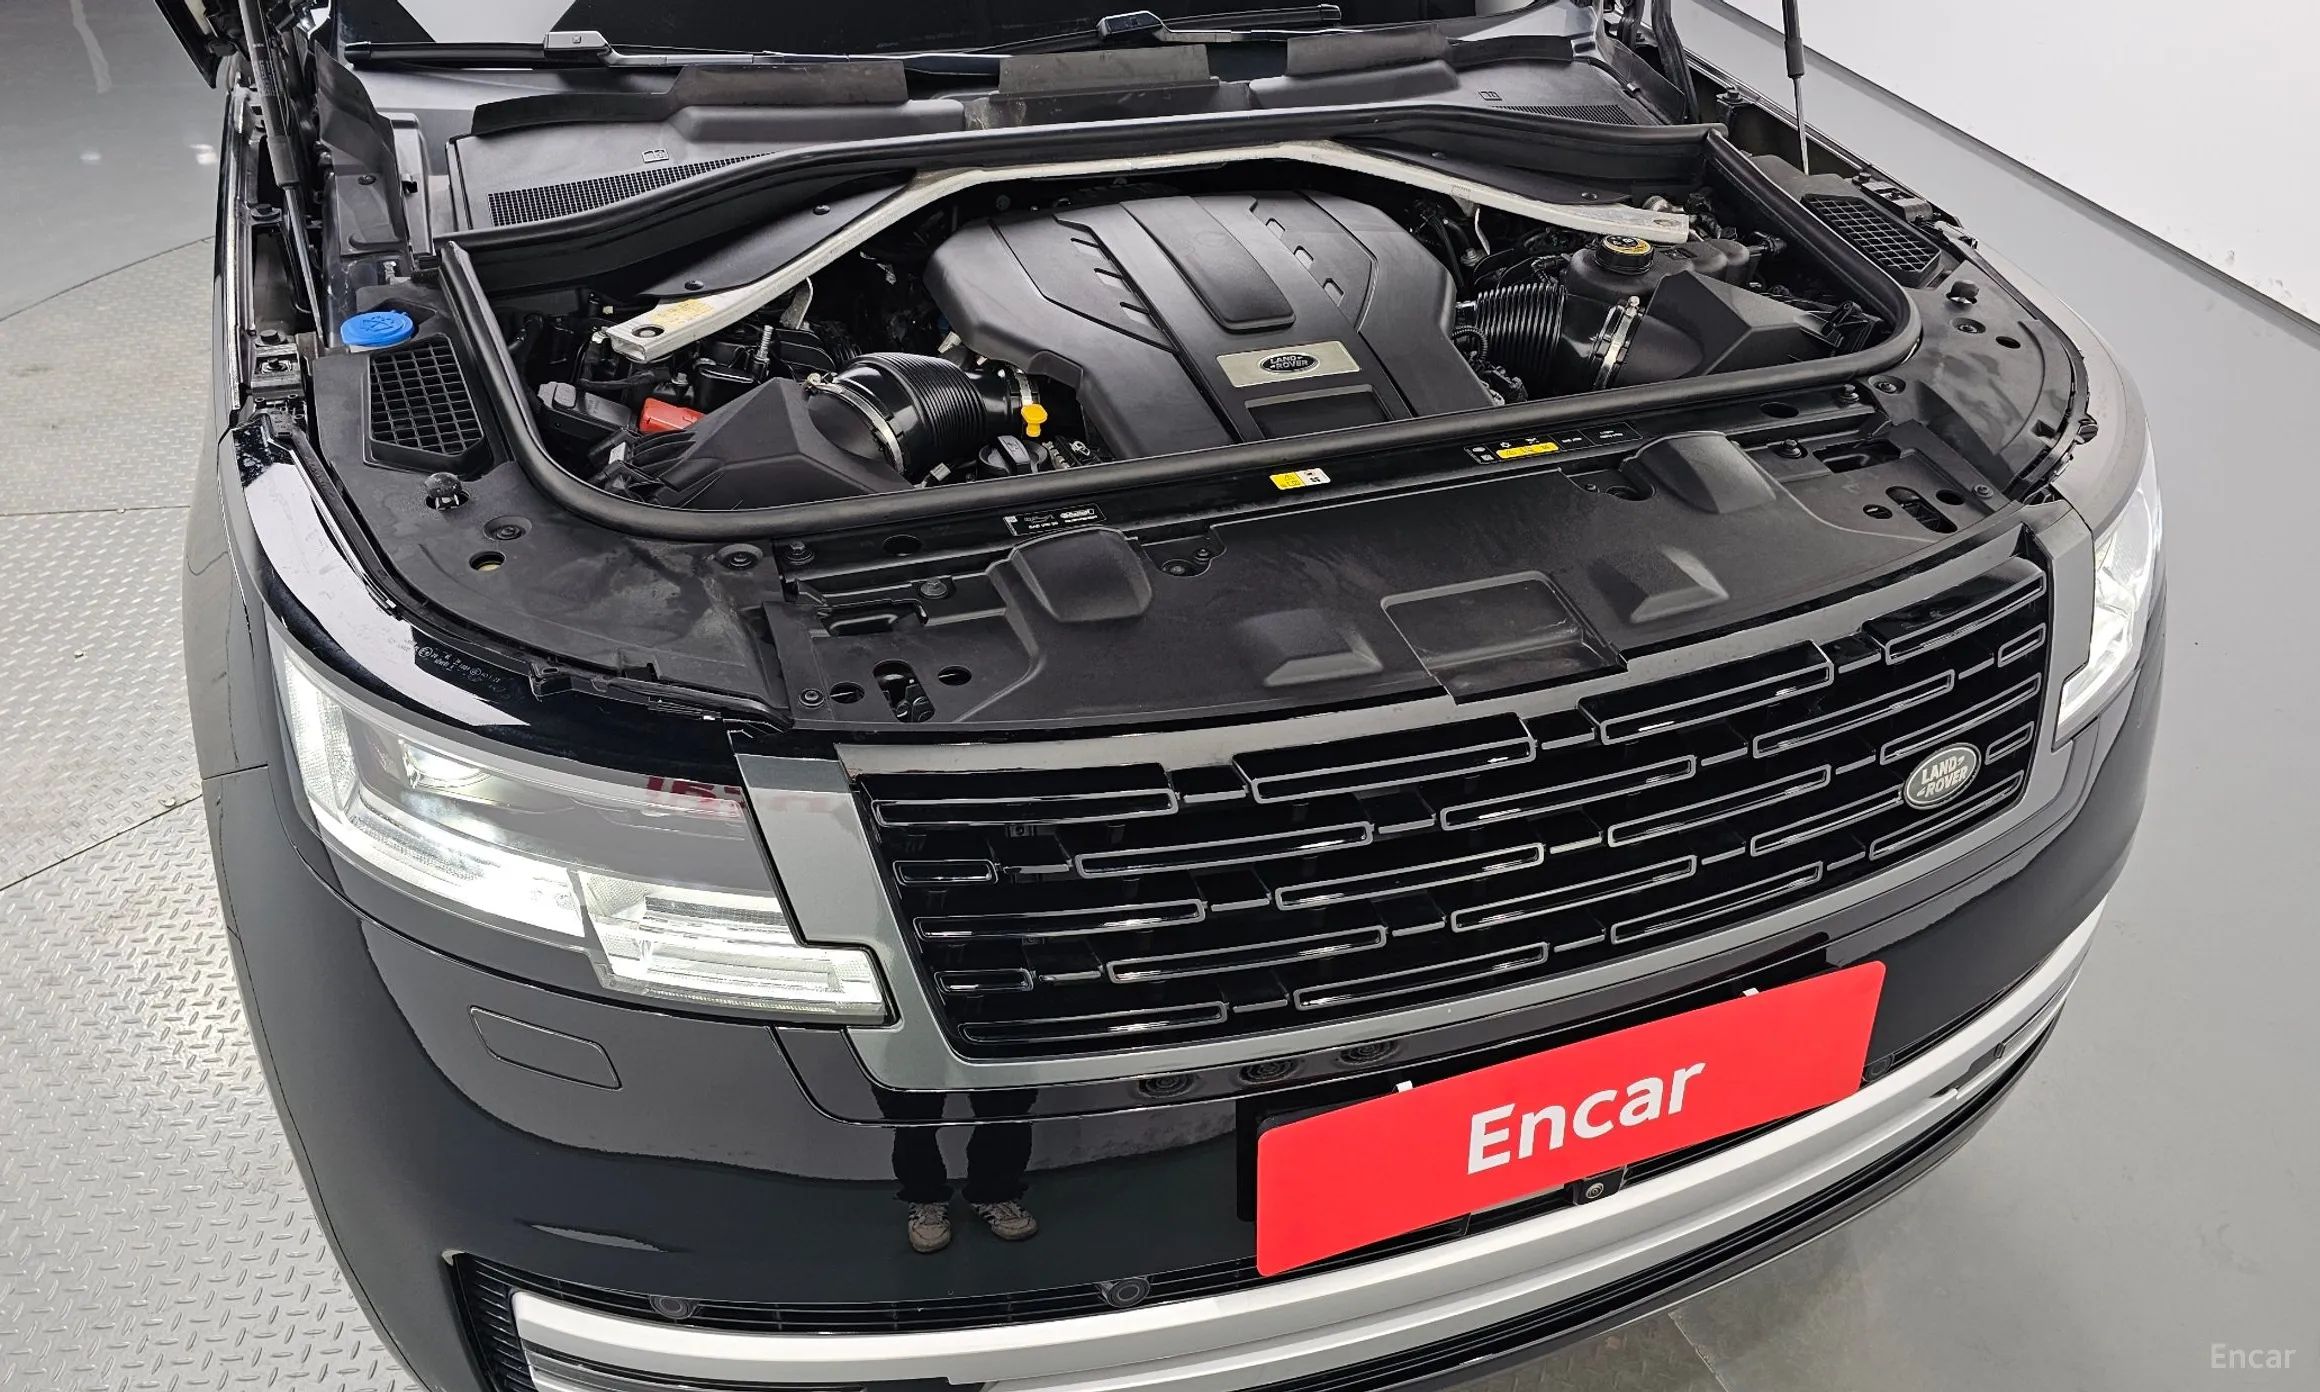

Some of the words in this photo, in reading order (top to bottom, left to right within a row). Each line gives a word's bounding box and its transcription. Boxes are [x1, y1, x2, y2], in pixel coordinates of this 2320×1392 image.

[1270, 355, 1297, 365] LAND
[1275, 359, 1309, 369] ROVER
[1921, 756, 1957, 785] LAND
[1924, 765, 1968, 798] ROVER
[1467, 1061, 1706, 1175] Encar
